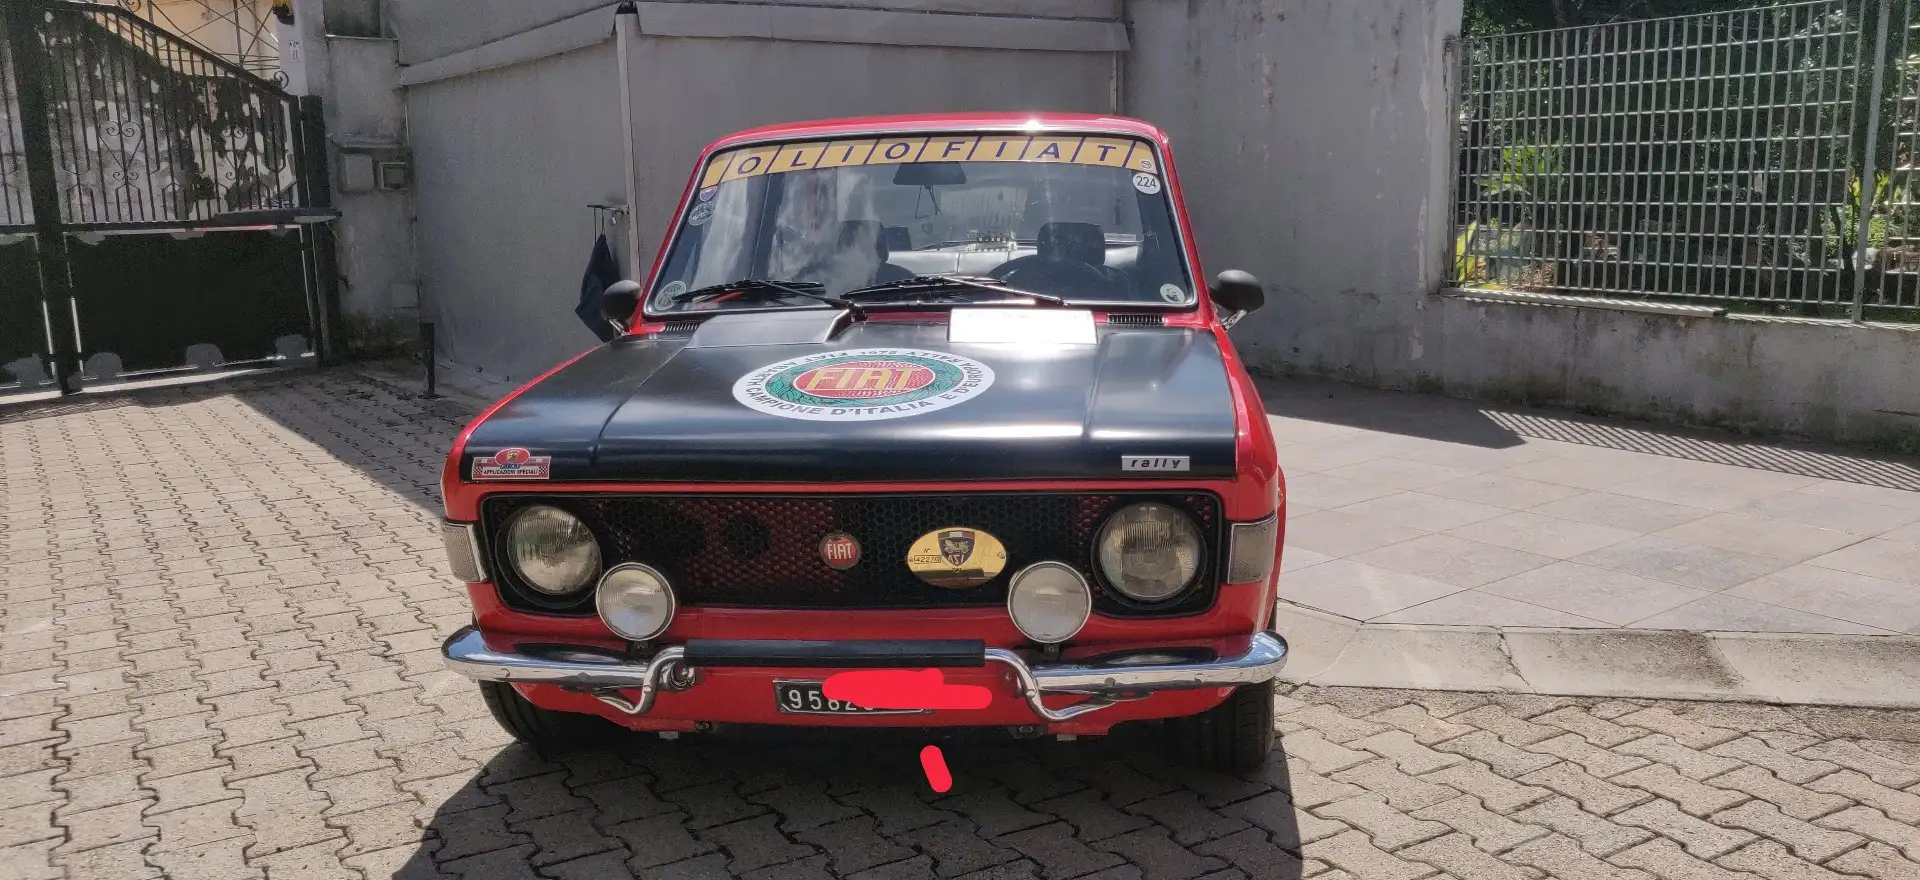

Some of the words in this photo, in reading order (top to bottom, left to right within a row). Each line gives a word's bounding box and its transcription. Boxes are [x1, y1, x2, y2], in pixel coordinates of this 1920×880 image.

[1136, 175, 1156, 188] 224
[805, 367, 922, 389] FIAT
[746, 387, 825, 415] CAMPIONE
[830, 400, 935, 415] D'ITALIA
[1131, 458, 1181, 468] rally
[827, 542, 852, 560] FIAT
